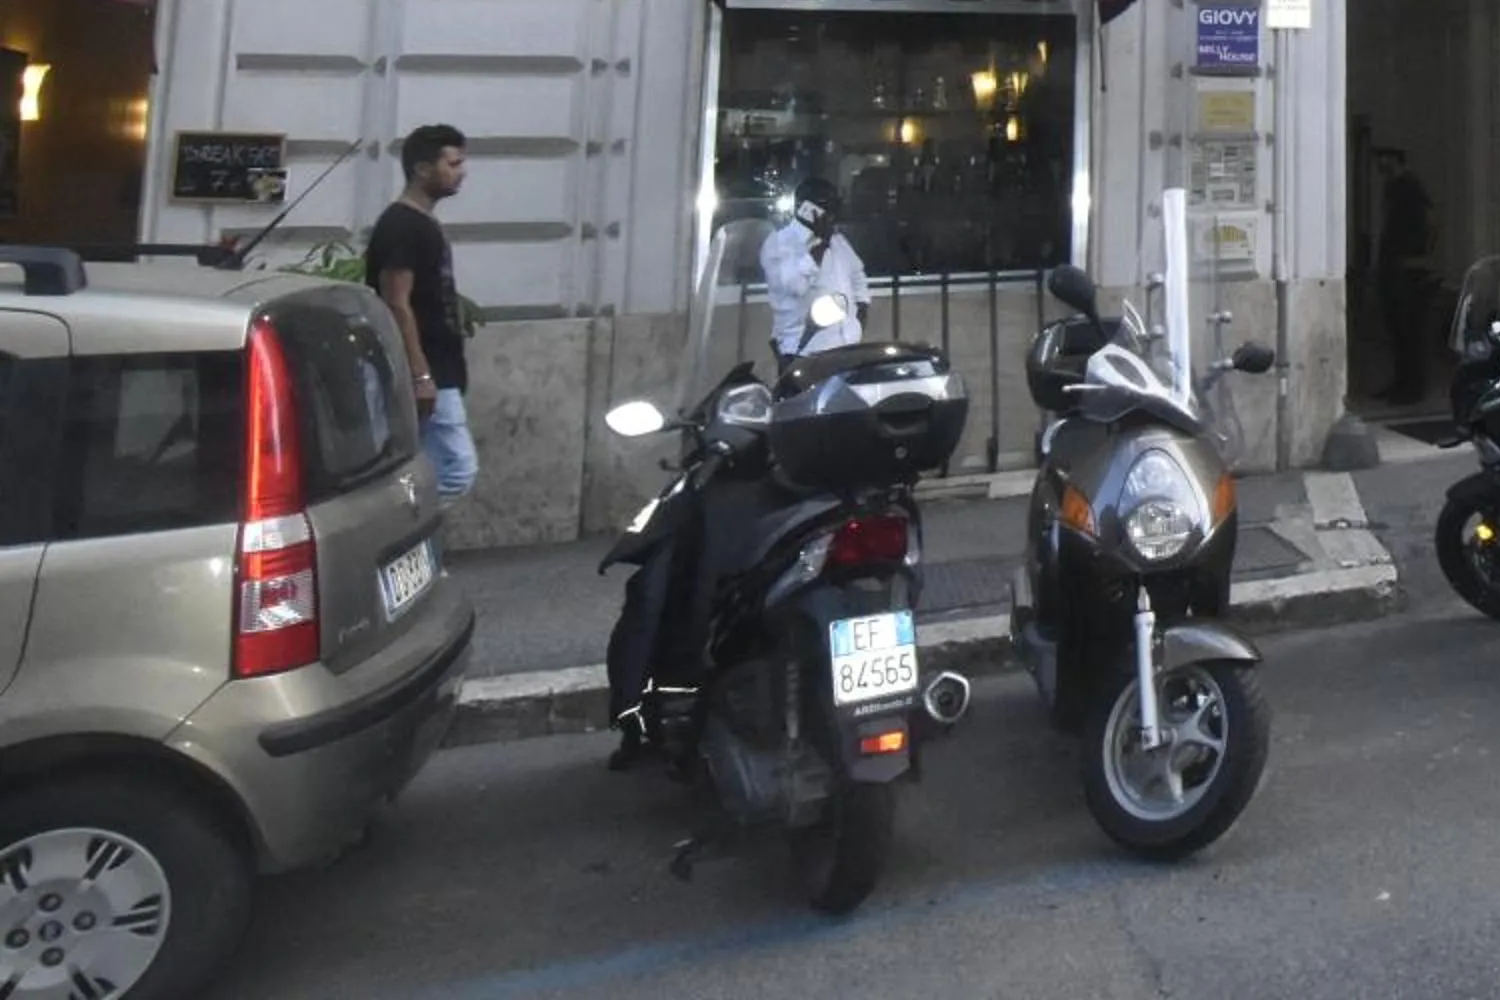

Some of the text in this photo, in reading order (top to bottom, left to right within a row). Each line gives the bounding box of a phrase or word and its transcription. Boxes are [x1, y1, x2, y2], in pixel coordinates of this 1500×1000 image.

[1199, 9, 1257, 25] GIOVY
[853, 619, 881, 651] EF
[839, 653, 913, 694] 84565
